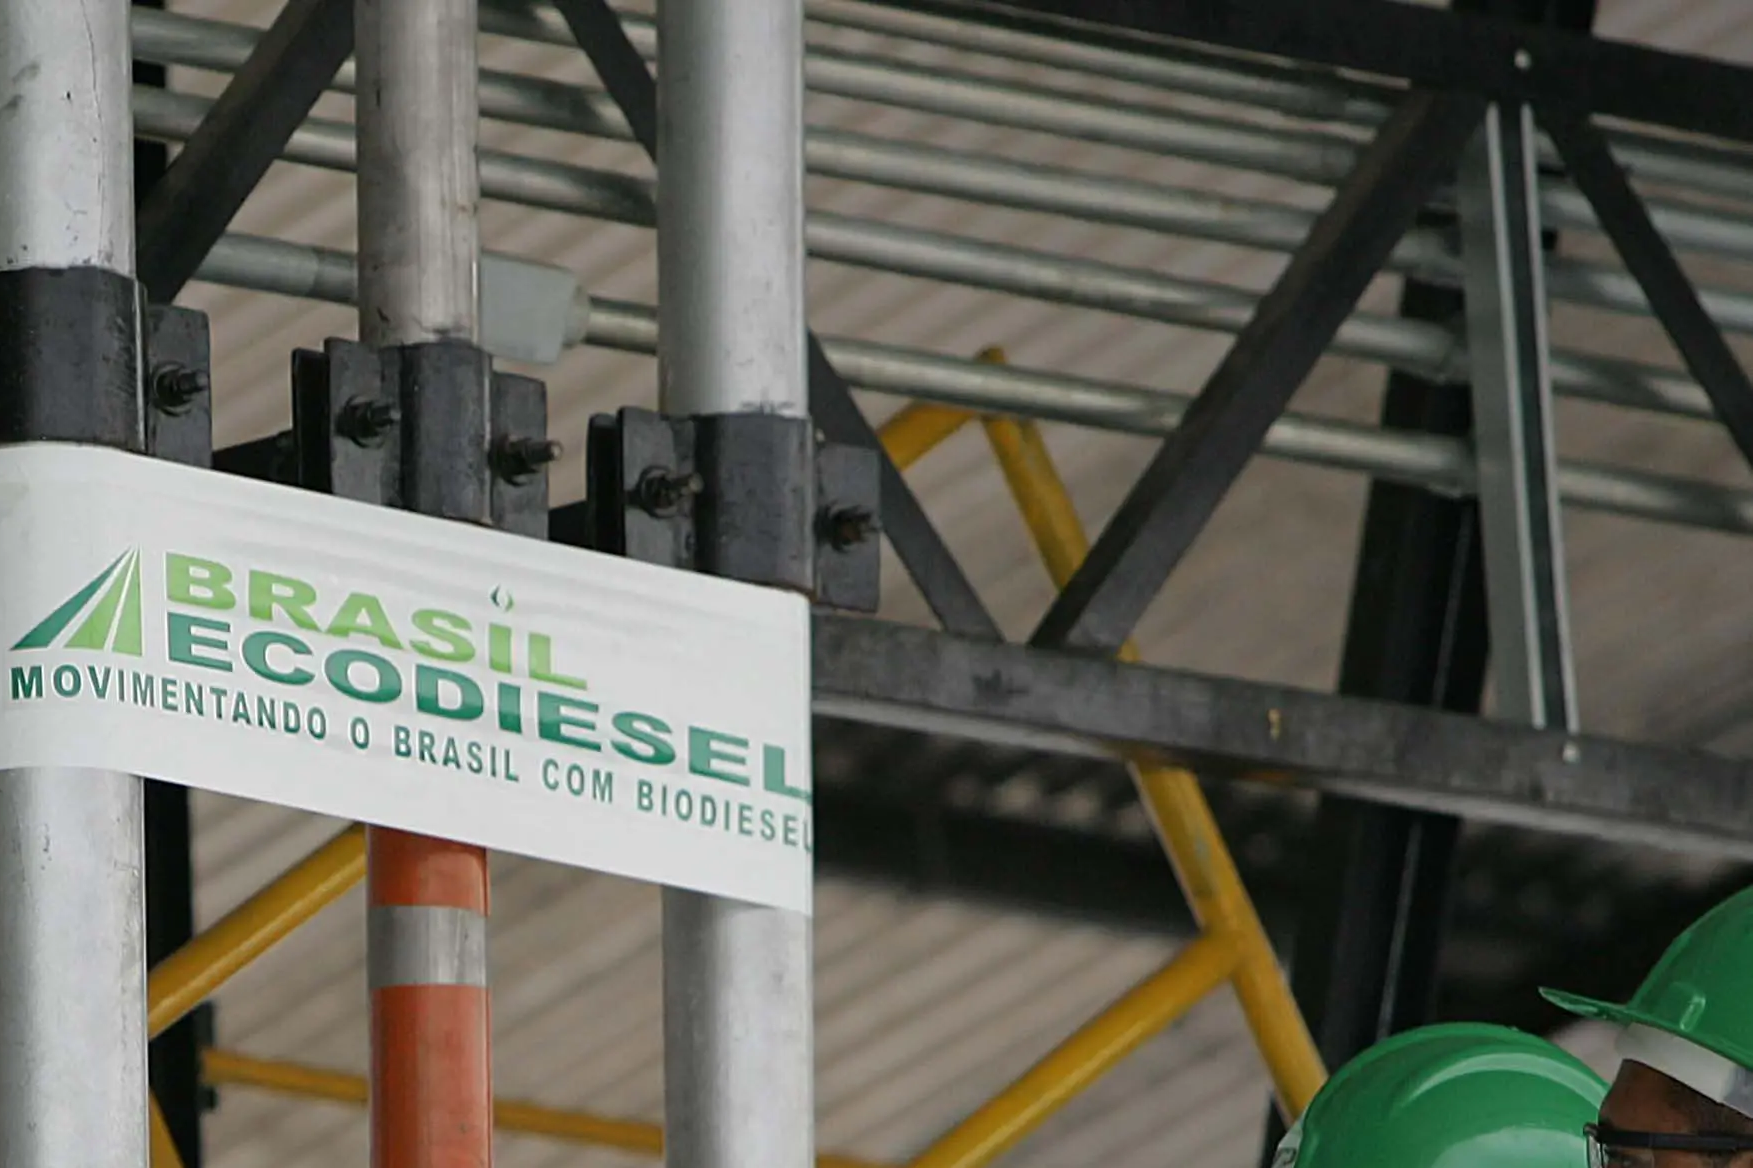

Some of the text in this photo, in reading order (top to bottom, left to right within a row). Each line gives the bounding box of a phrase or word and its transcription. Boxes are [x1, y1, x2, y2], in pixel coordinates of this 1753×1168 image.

[165, 551, 588, 690] BRASIL
[167, 609, 814, 803] ECODIESEL
[11, 663, 813, 854] MOVIMENTANDO O BRASIL COM BIODIESEL
